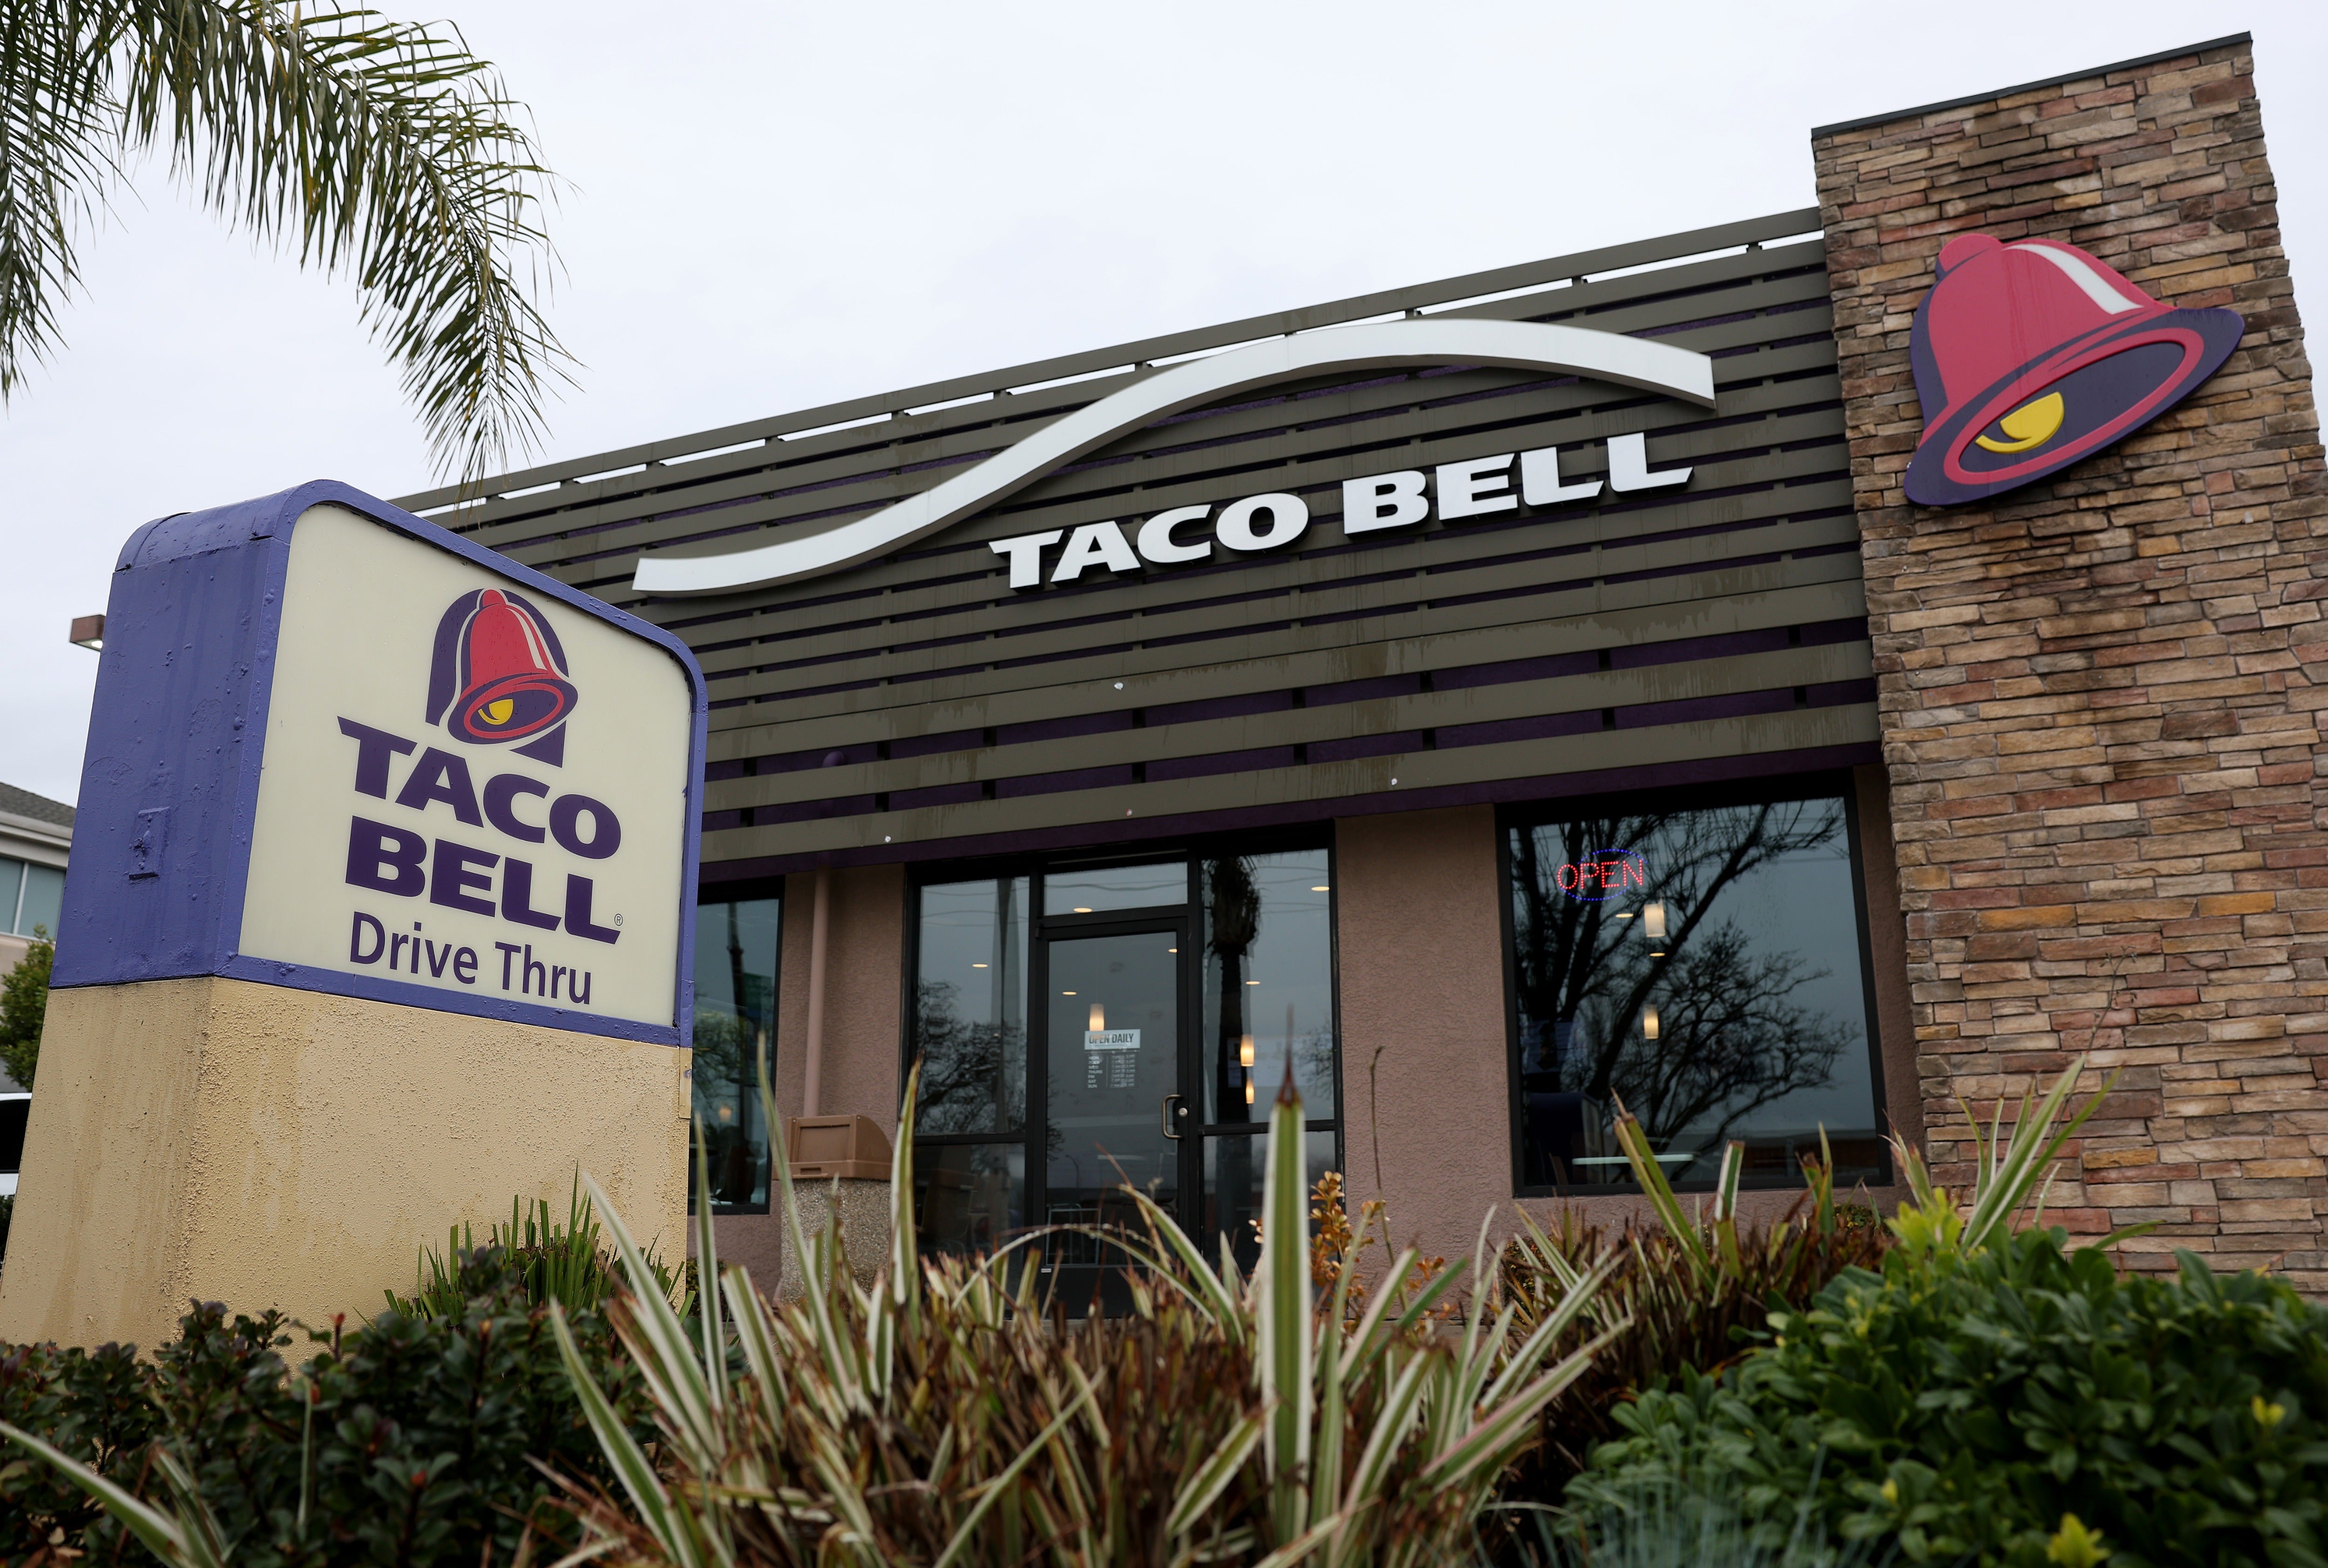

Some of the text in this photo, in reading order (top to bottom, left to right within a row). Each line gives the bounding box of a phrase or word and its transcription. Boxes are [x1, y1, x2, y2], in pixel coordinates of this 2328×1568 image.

[988, 432, 1693, 589] TACO BELL
[337, 716, 622, 859] TACO
[345, 815, 621, 945] BELL
[1557, 859, 1644, 889] OPEN
[350, 911, 591, 1005] Drive Thru
[1111, 1033, 1134, 1043] DAILY
